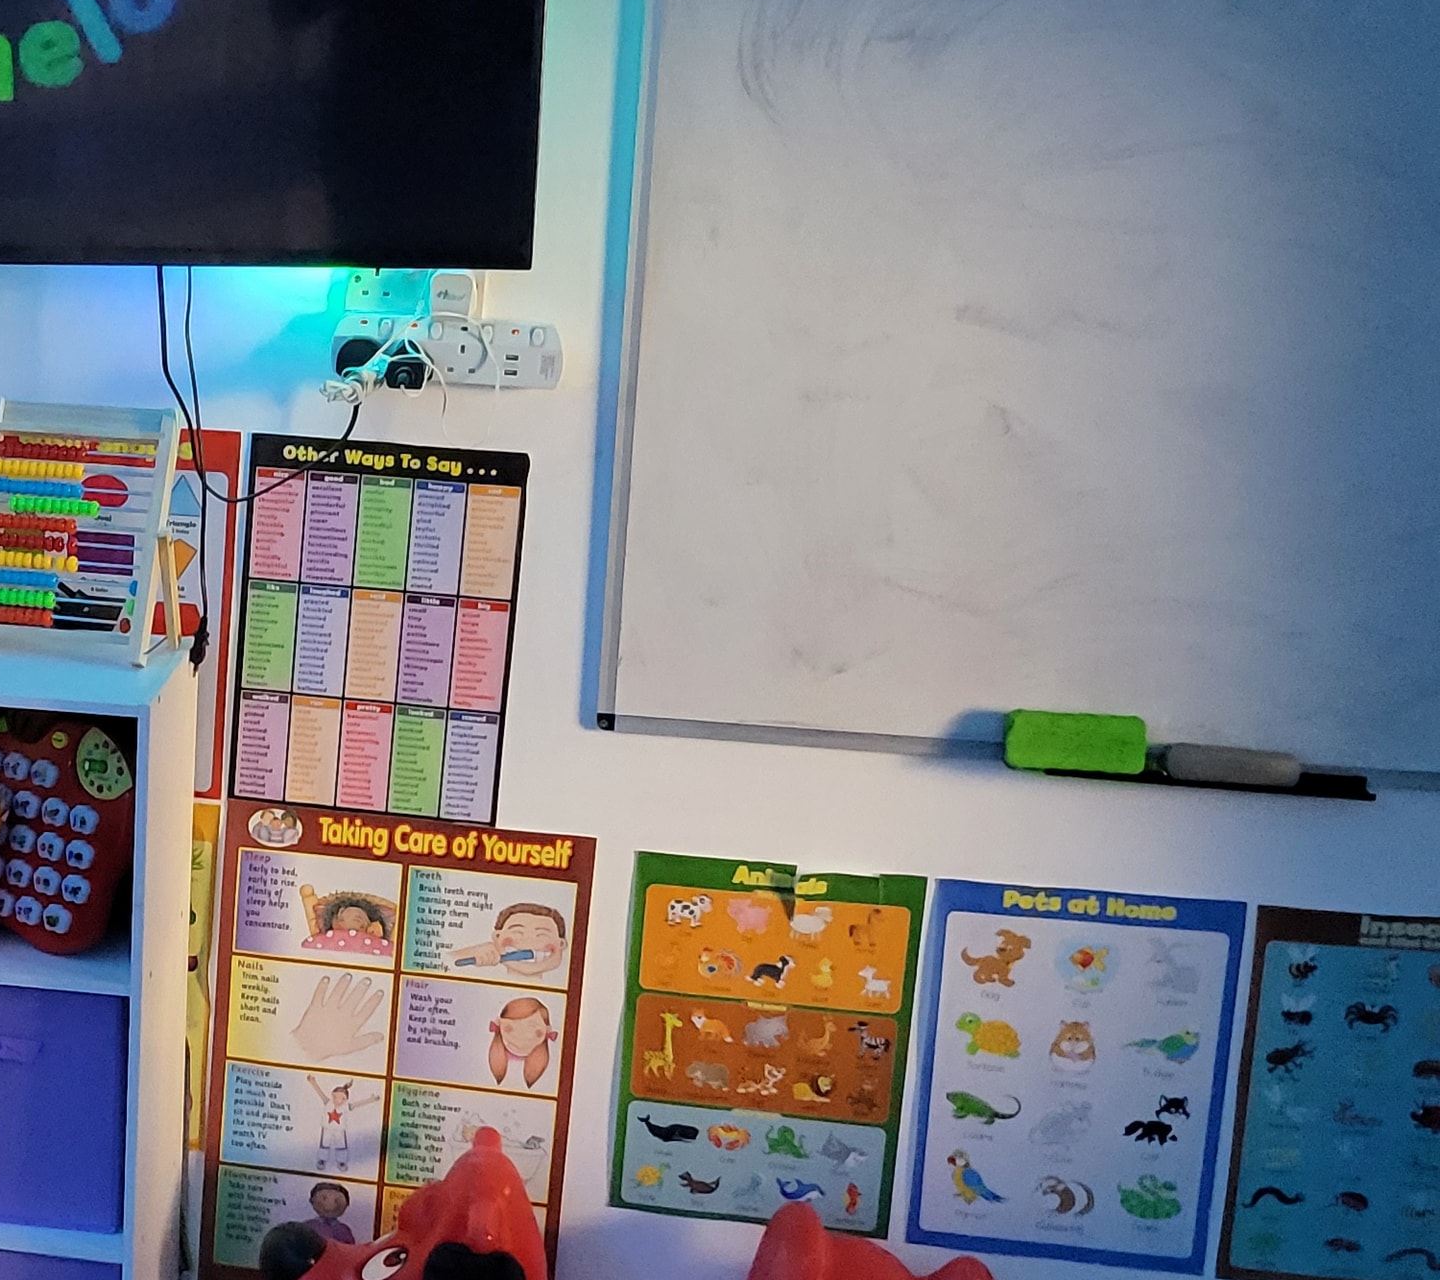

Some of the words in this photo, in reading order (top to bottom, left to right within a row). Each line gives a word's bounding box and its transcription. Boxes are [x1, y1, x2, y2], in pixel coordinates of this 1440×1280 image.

[344, 449, 395, 471] Ways
[399, 453, 422, 469] To
[426, 456, 463, 477] Say
[319, 817, 390, 857] Taking
[393, 823, 448, 857] Care
[451, 830, 478, 859] of
[480, 834, 574, 870] Yourself
[413, 869, 442, 881] Teeth
[246, 885, 273, 899] Plenty
[418, 883, 442, 895] Brush
[444, 887, 465, 896] teeth
[467, 889, 490, 901] every
[1001, 890, 1062, 913] Pets
[1067, 895, 1101, 916] at
[1106, 897, 1178, 921] Home
[237, 959, 265, 971] Nails
[241, 971, 260, 982] Trim
[240, 992, 260, 1004] Keep
[410, 992, 433, 1003] Wash
